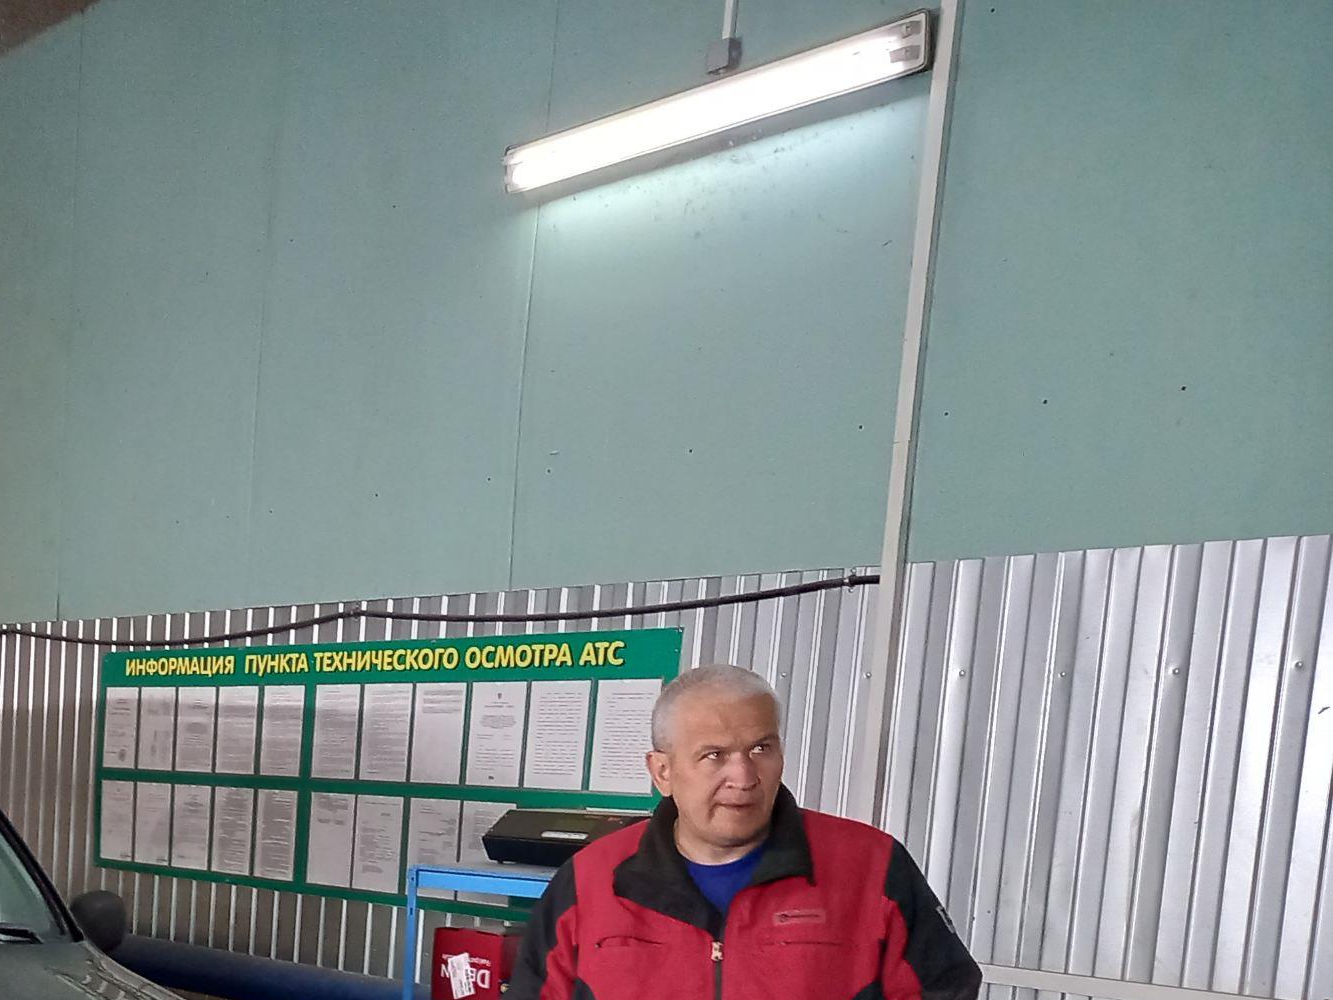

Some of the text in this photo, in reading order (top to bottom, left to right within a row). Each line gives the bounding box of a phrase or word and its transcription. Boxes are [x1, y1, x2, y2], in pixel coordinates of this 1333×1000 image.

[125, 640, 626, 677] ИНФОРМАЦИЯ ПУНКТА ТЕХНИЧЕСКОГО ОСМОТРА АТС
